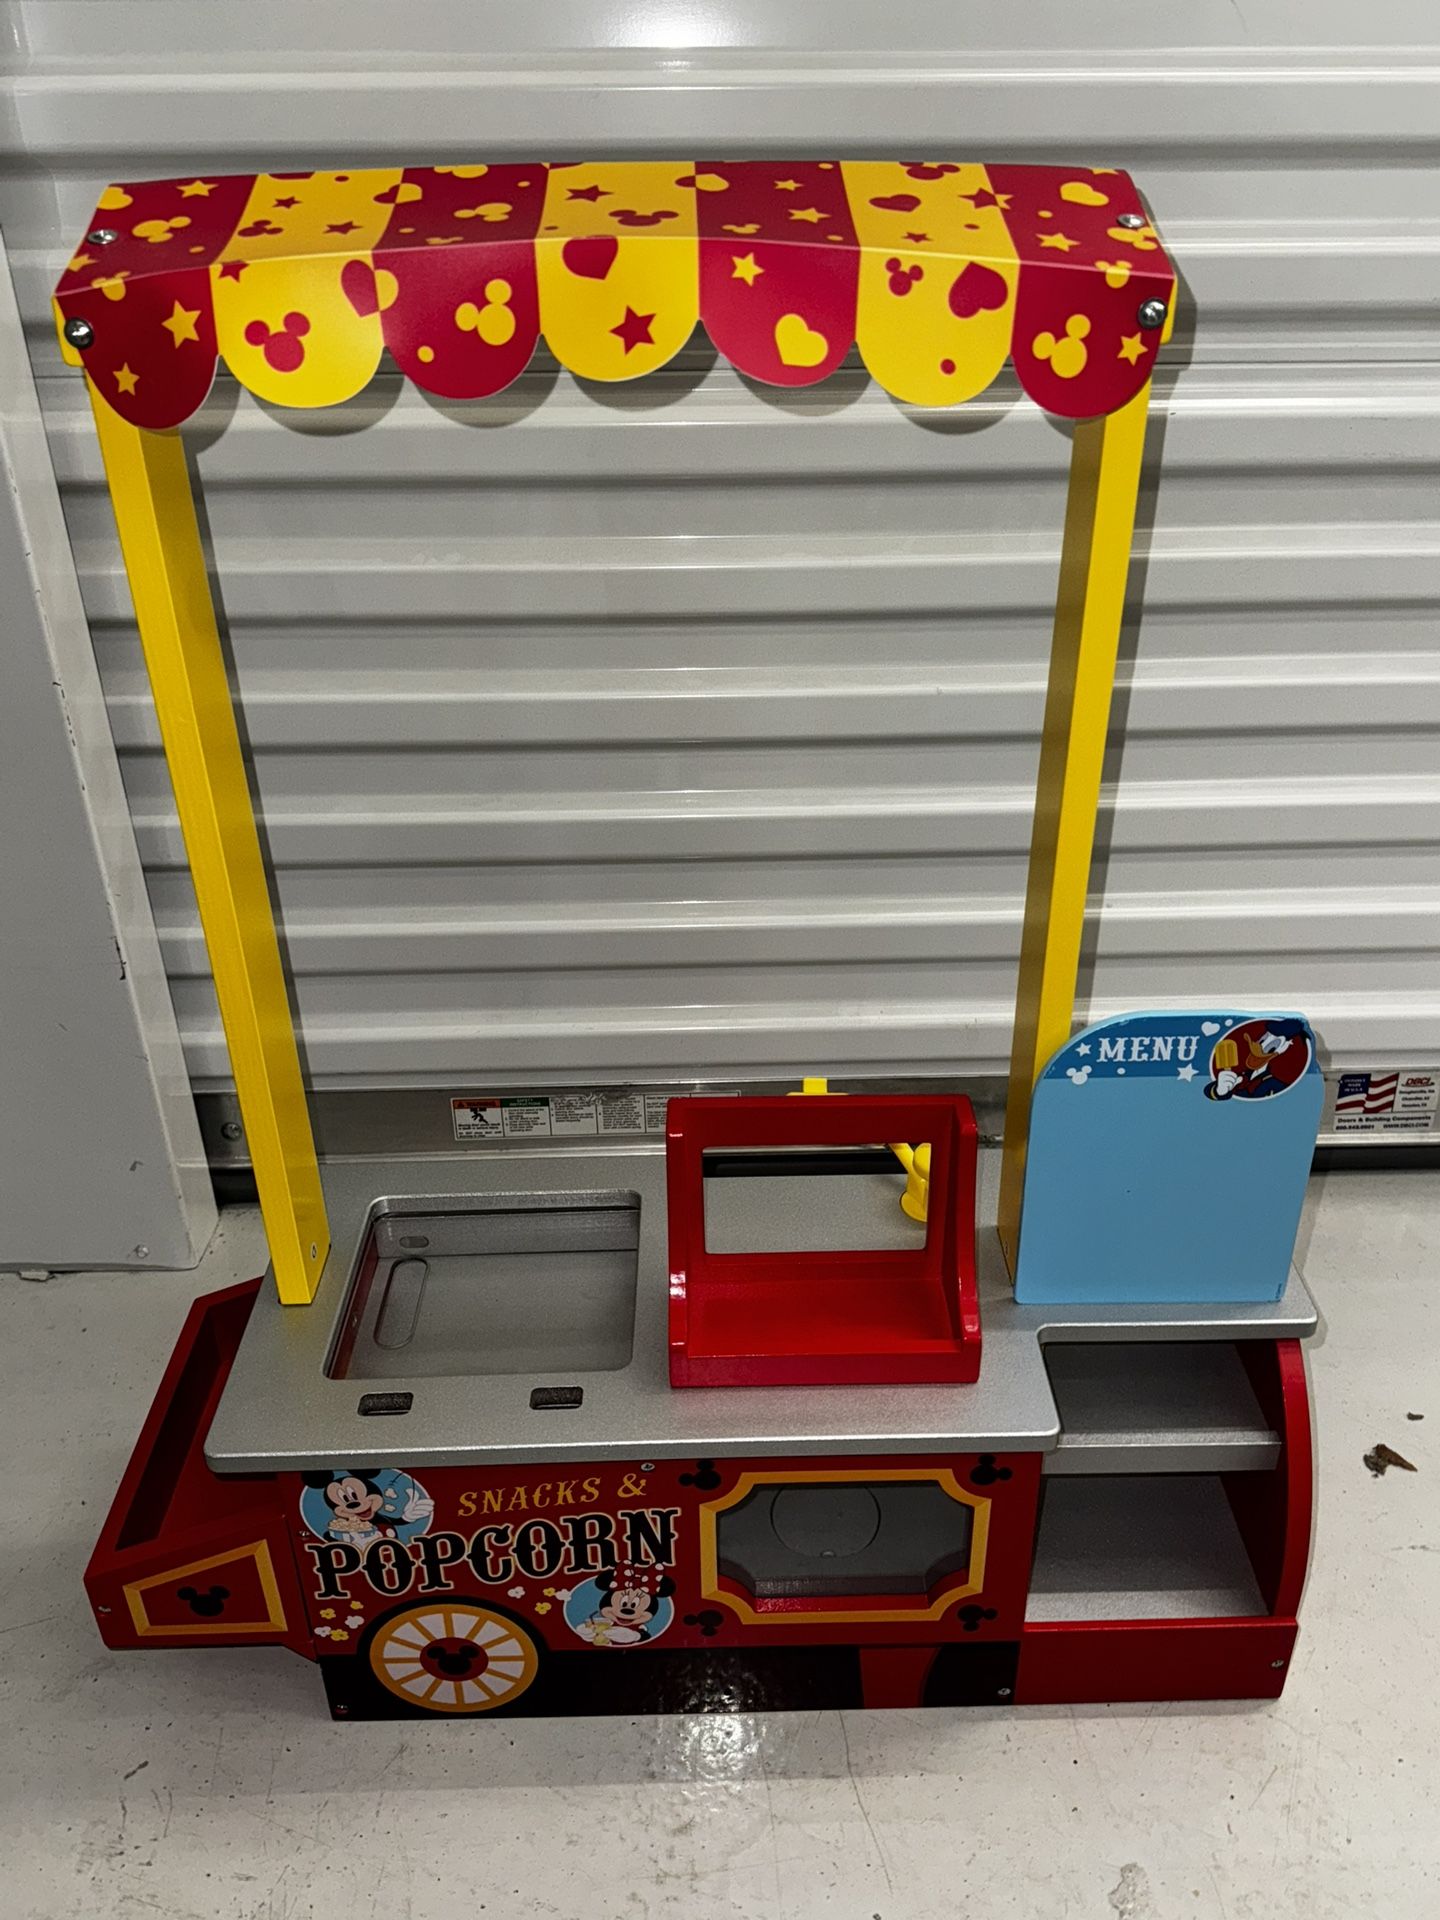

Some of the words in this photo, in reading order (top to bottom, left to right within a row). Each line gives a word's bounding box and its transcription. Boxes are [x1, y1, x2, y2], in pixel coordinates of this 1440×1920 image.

[1096, 1036, 1200, 1062] MENU
[457, 1476, 602, 1517] SNACKS
[616, 1472, 647, 1498] &
[305, 1507, 682, 1599] POPCORN
